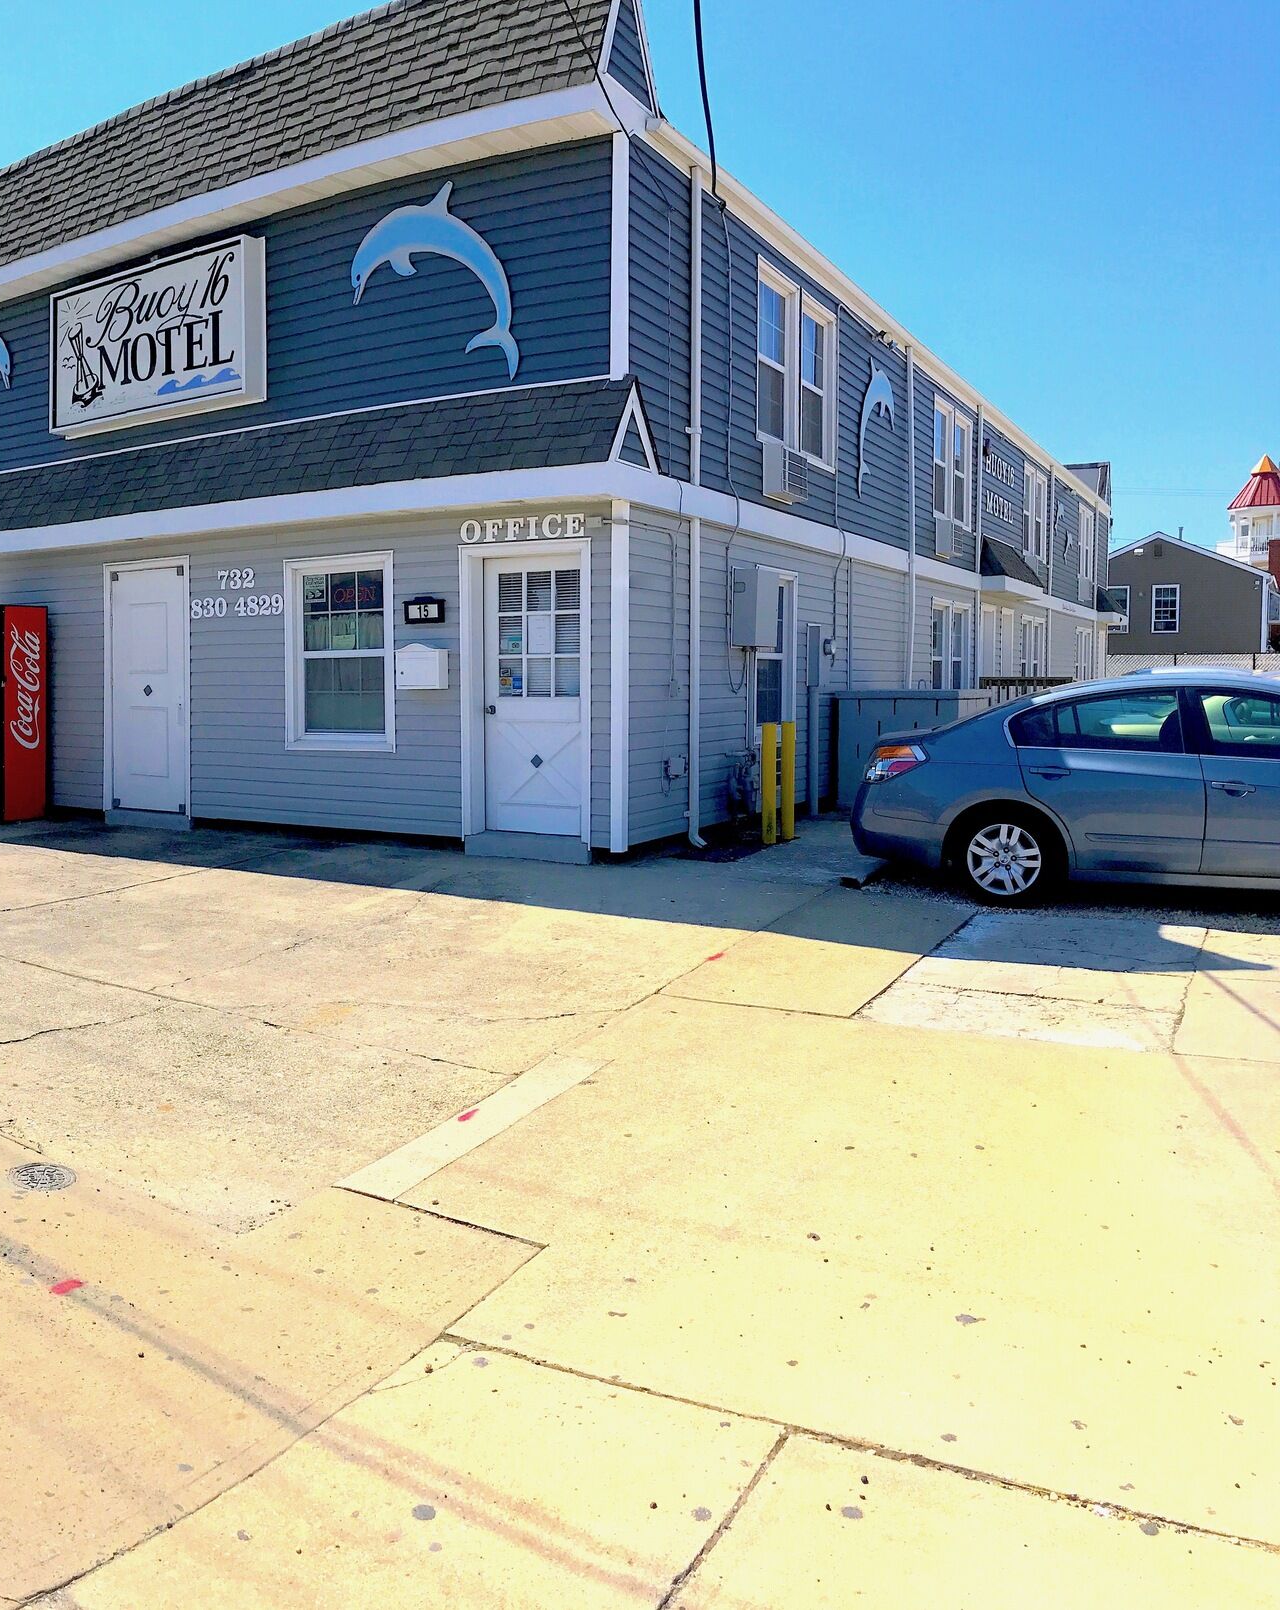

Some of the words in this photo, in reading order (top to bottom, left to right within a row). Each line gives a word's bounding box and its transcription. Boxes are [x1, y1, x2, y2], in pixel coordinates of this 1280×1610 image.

[85, 278, 203, 348] Buoy
[200, 251, 235, 309] 16
[96, 310, 235, 391] MOTEL
[985, 489, 1014, 524] MOTEL
[460, 513, 585, 544] OFFICE
[217, 567, 255, 590] 732
[334, 585, 377, 603] OPEN
[190, 597, 228, 619] 830
[234, 593, 284, 617] 4829
[417, 605, 429, 618] 15
[9, 622, 41, 750] Coca-Cola
